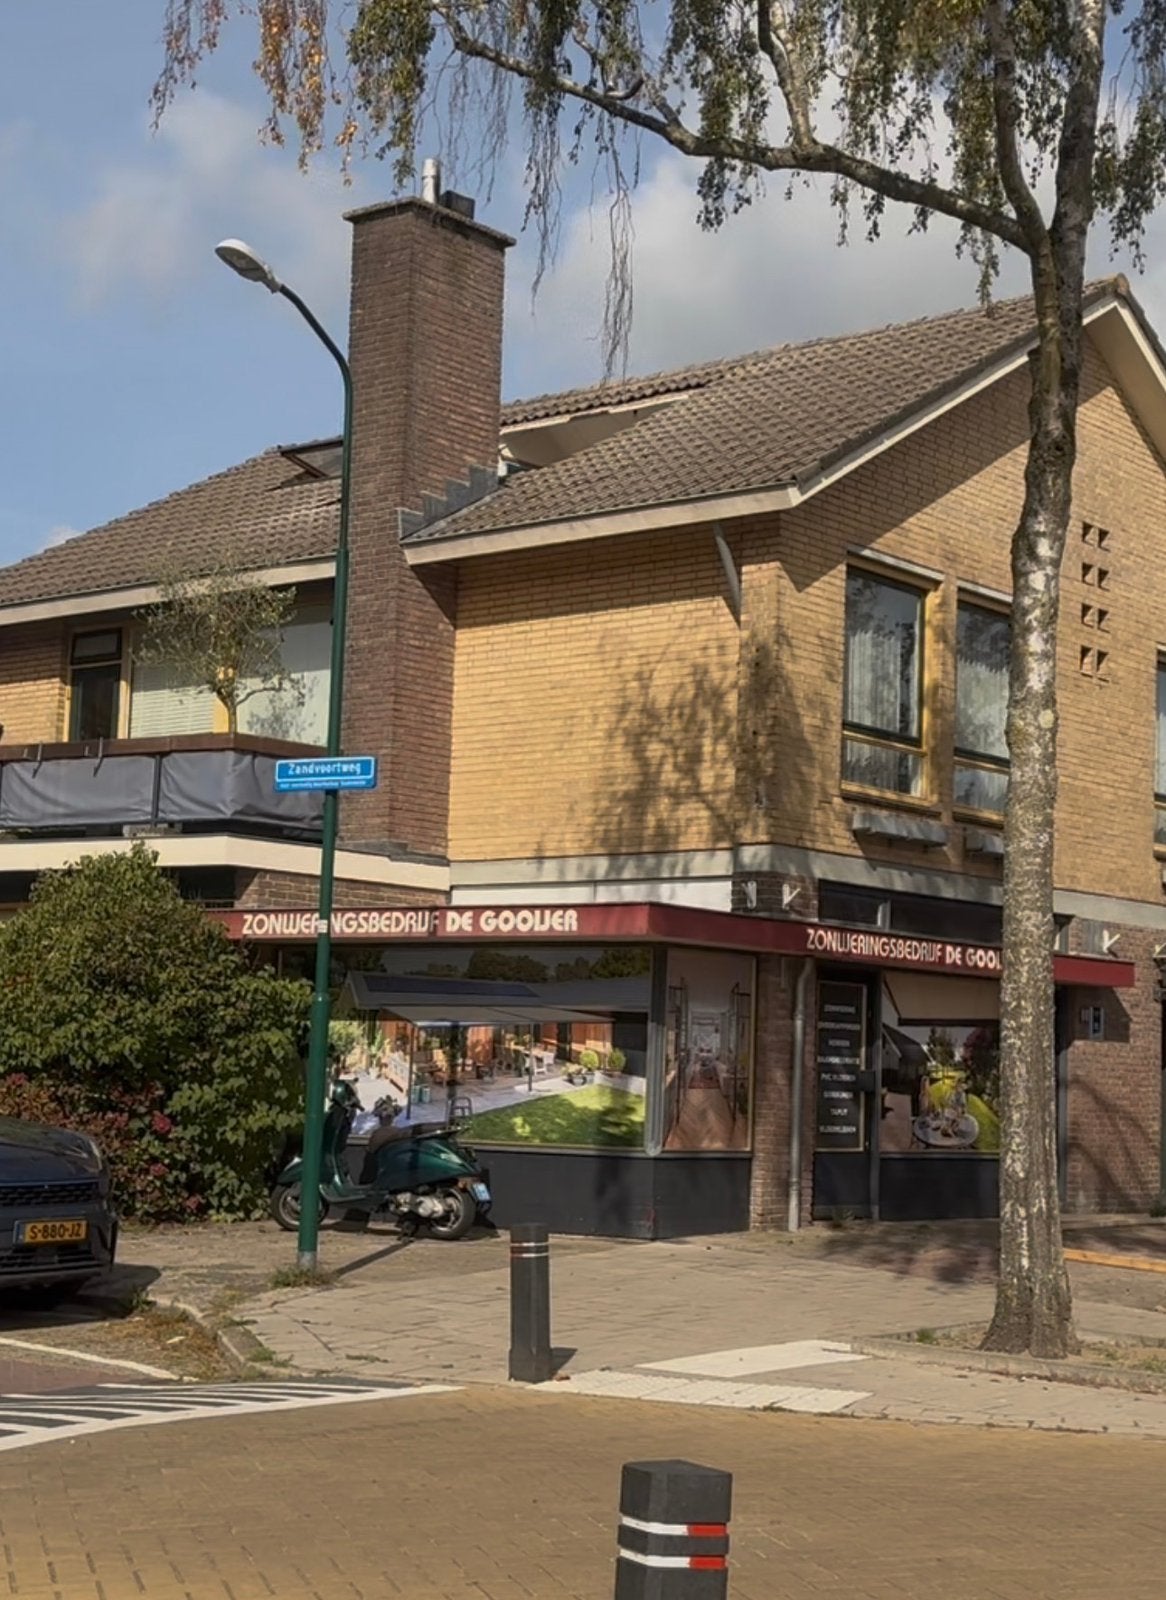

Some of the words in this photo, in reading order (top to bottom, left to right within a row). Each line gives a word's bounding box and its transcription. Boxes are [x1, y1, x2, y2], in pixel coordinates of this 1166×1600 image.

[288, 762, 361, 775] Zandvoortweg
[243, 911, 439, 935] ZONWERNGSBEDRIJF
[446, 911, 473, 932] DE
[806, 929, 942, 962] ZONWERINGSBEDRIJF
[945, 946, 962, 966] DE
[29, 1222, 83, 1240] S-880-JZ
